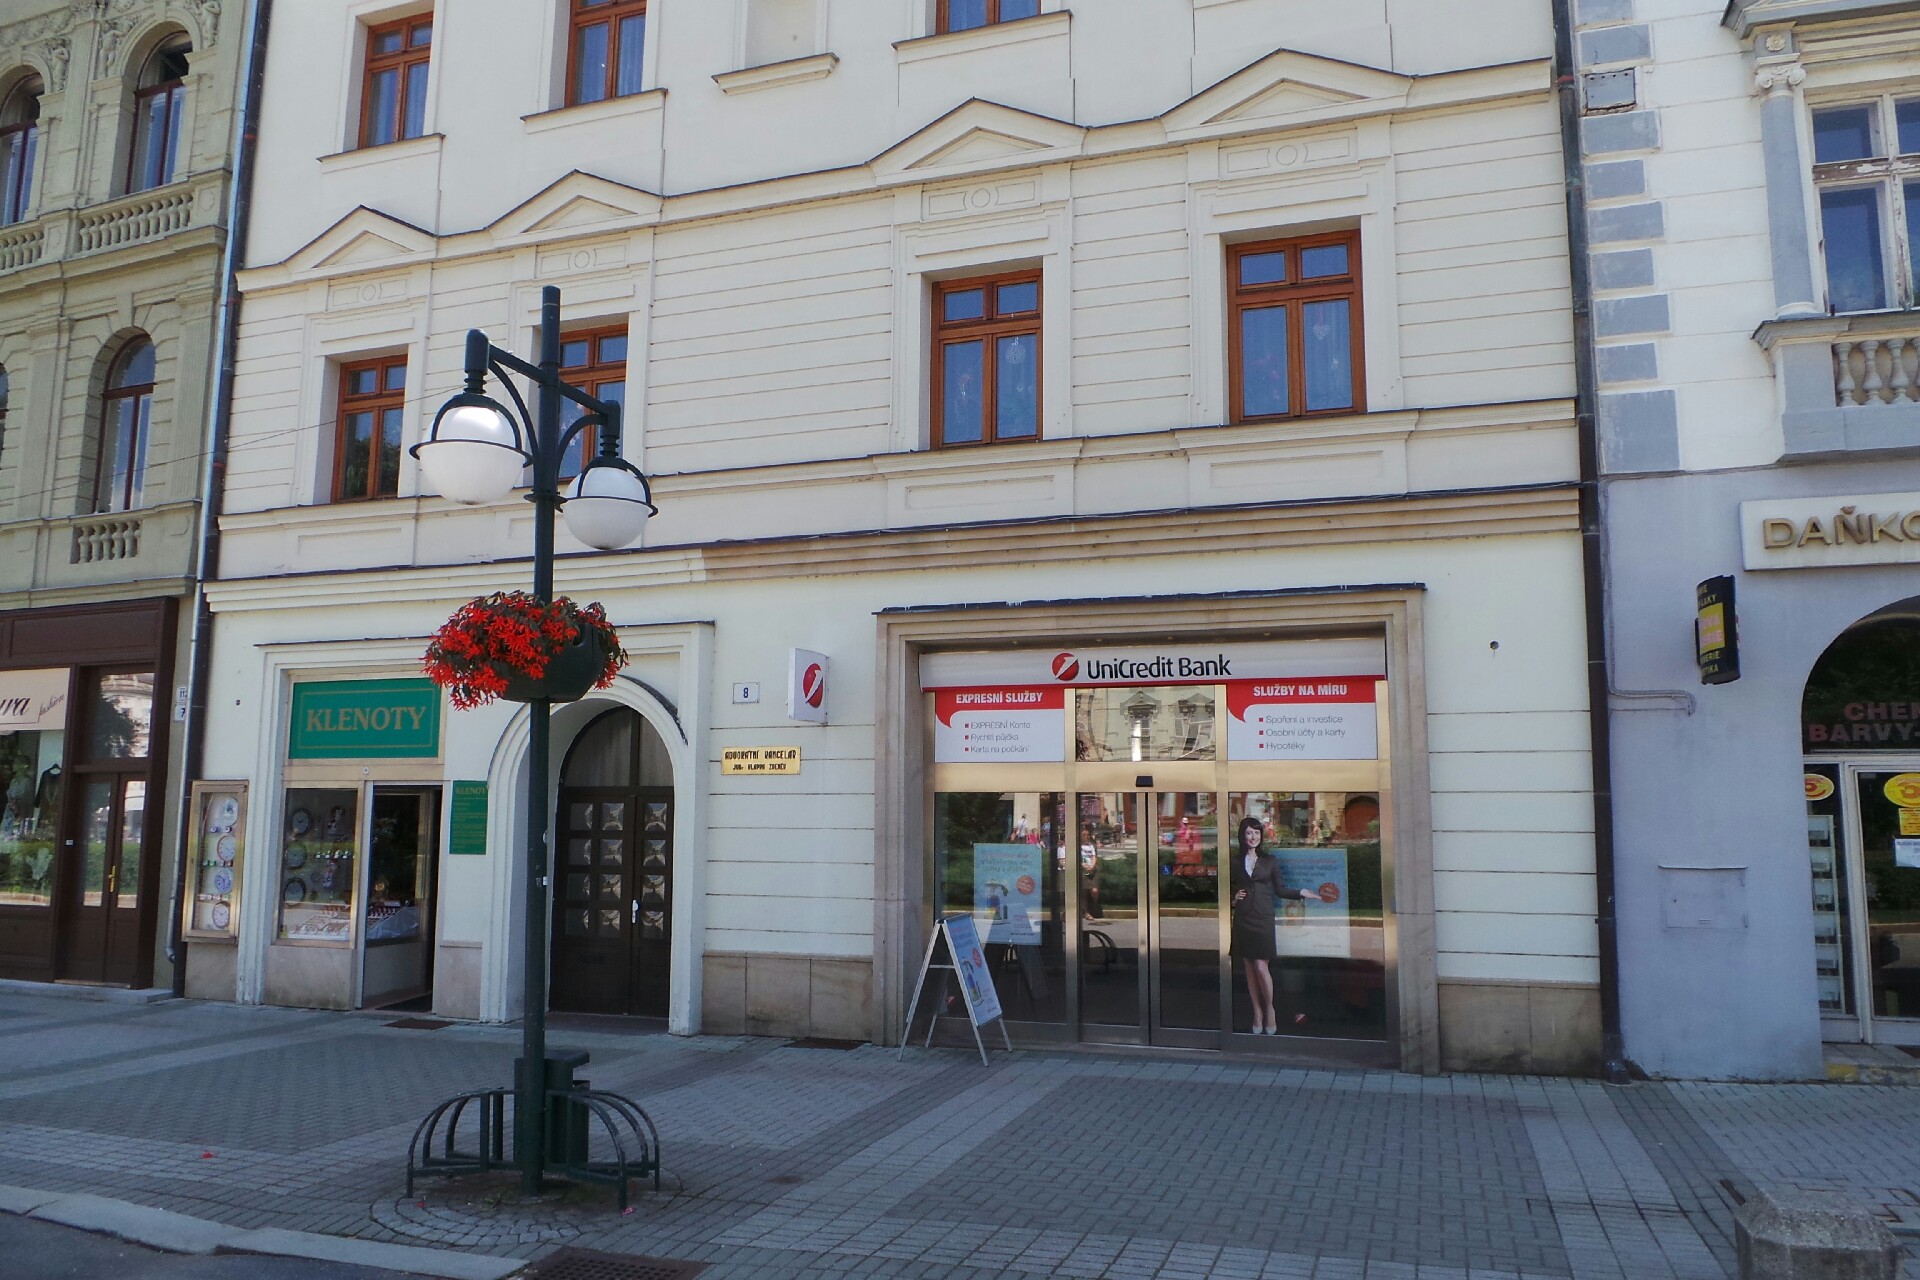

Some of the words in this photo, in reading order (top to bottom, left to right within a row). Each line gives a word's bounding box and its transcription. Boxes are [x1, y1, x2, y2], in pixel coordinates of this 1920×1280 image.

[1087, 656, 1174, 679] UniCredit
[1178, 654, 1232, 677] Bank
[743, 687, 749, 698] 8
[1253, 684, 1295, 697] SLUŽBY
[1299, 686, 1315, 696] NA
[1317, 683, 1348, 696] MÍRU
[956, 691, 1003, 704] EXPRESNÍ
[1005, 690, 1043, 703] SLUŽBY
[181, 708, 186, 718] 7
[306, 705, 427, 732] KLENOTY
[1265, 715, 1298, 724] Spoření
[1306, 715, 1343, 723] investice
[970, 721, 1008, 729] EXPRESNÍ
[1009, 721, 1031, 729] Konto
[995, 732, 1019, 742] půjčka
[1265, 728, 1296, 737] Osobní
[1297, 728, 1315, 738] účty
[1324, 728, 1346, 738] karty
[970, 745, 990, 753] Karta
[1001, 745, 1030, 754] počkání
[1265, 742, 1305, 751] Hypotéky
